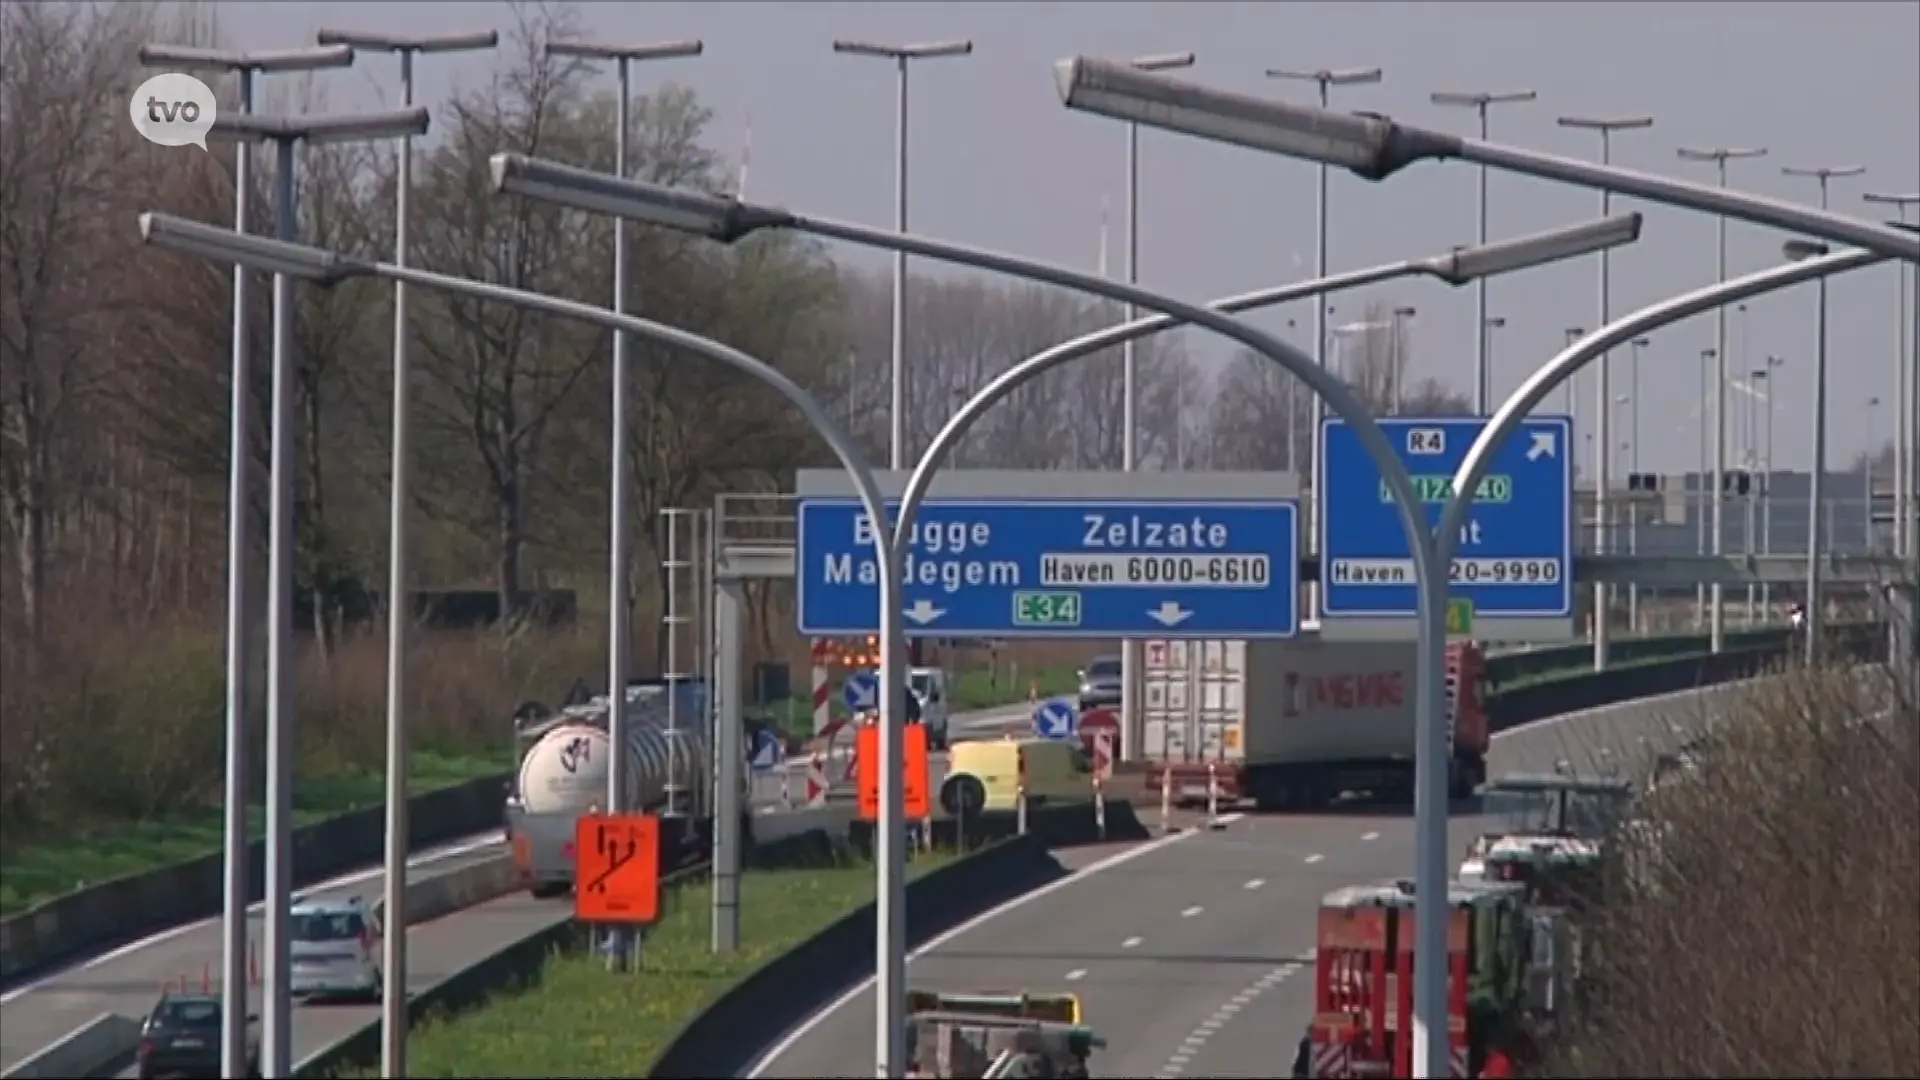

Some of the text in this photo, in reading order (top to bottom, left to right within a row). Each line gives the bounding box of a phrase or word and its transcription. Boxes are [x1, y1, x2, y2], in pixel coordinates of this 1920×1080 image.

[1410, 432, 1441, 451] R4
[1083, 515, 1228, 548] Zelzate
[824, 552, 1020, 592] Madegem
[1044, 557, 1266, 584] Haven 6000-6610
[1334, 563, 1405, 581] Haven
[1018, 595, 1077, 622] E34
